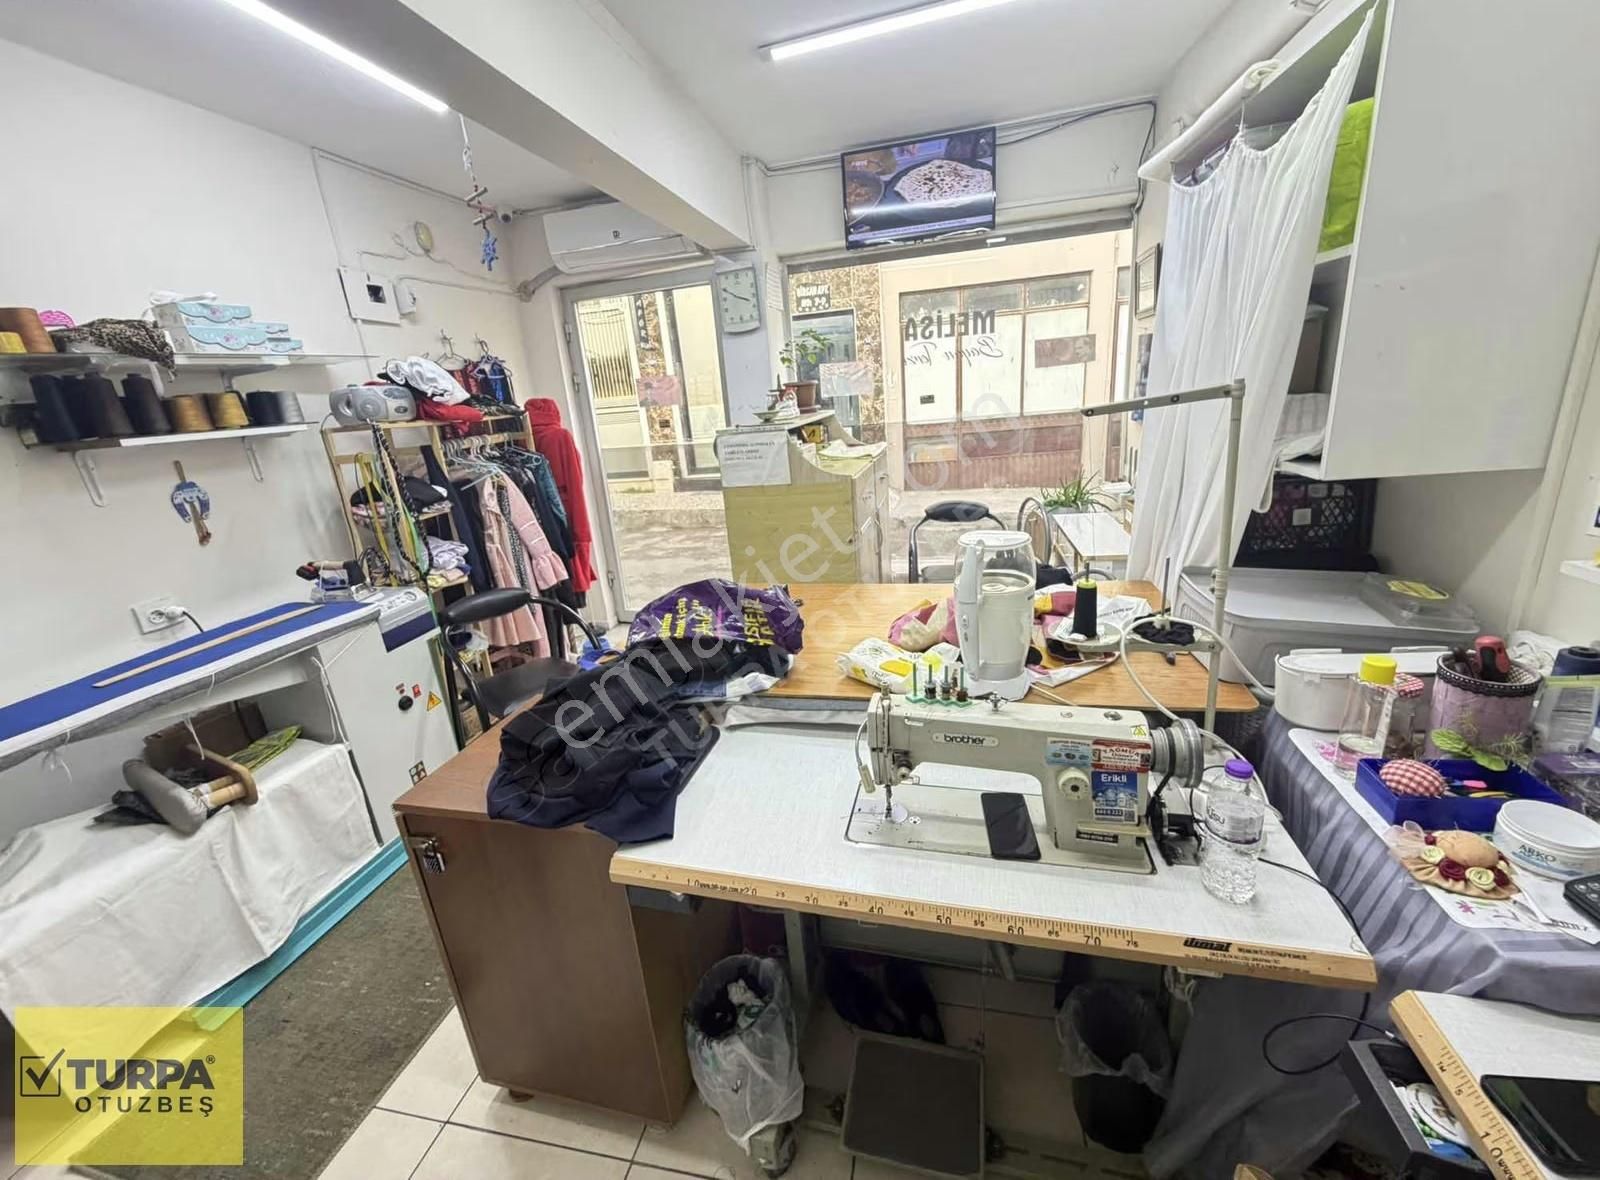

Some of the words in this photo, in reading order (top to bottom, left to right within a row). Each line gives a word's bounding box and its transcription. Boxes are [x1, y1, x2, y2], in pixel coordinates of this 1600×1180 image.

[943, 733, 986, 745] brother
[1100, 773, 1127, 783] Erikli
[1518, 844, 1557, 863] ARKO
